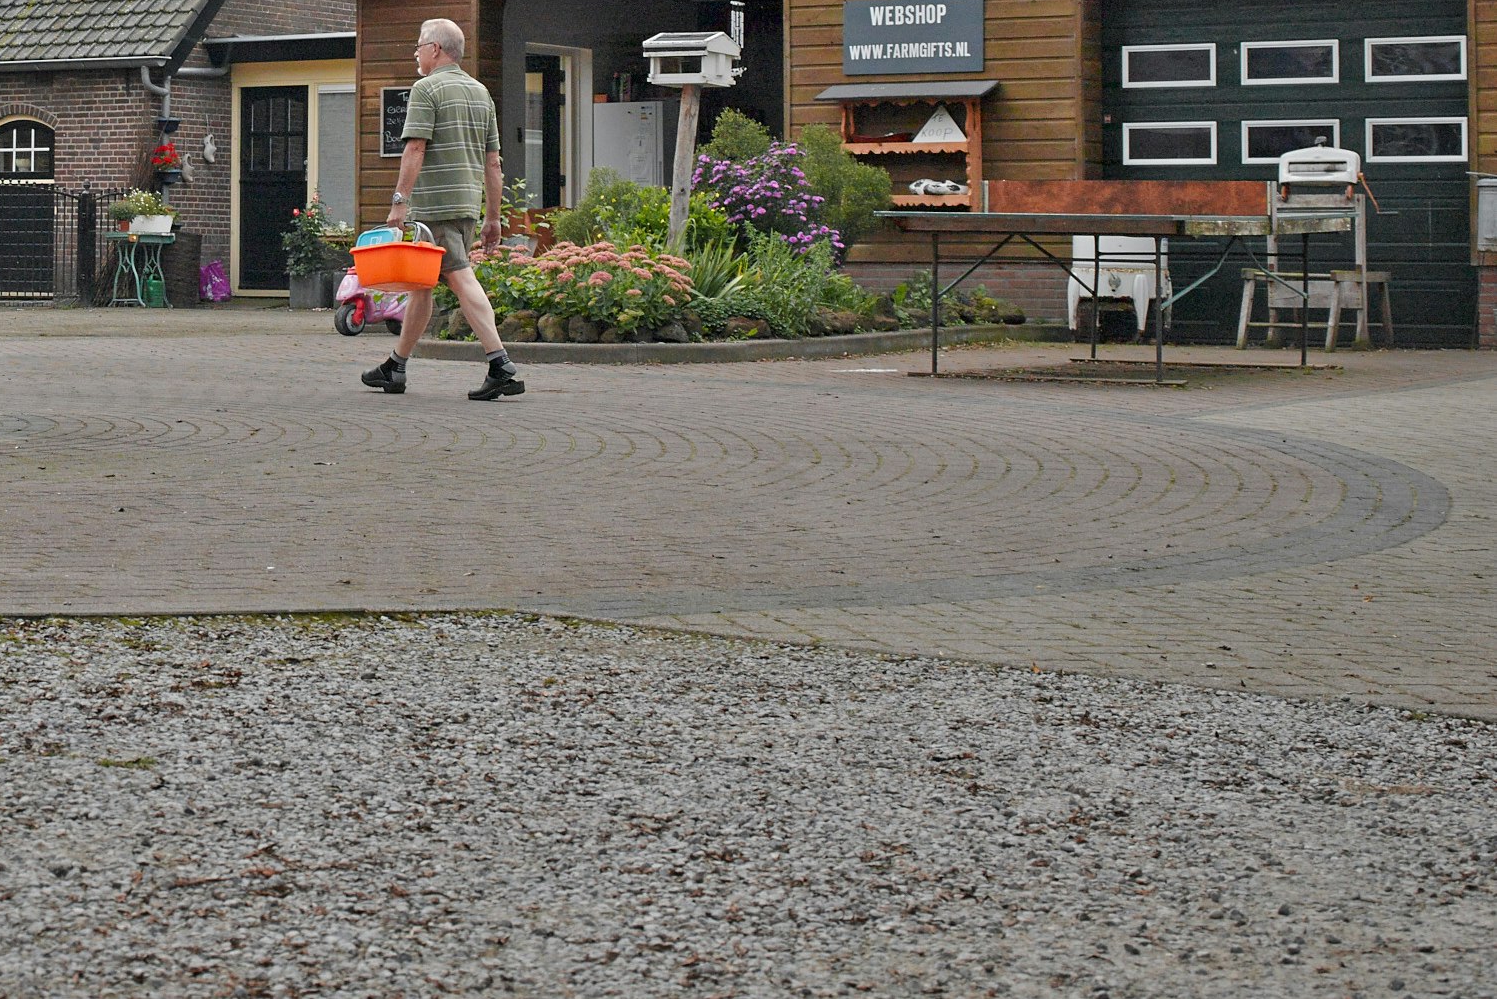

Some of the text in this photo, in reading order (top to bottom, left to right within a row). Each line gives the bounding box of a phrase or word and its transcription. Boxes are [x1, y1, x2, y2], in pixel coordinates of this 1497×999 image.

[869, 3, 947, 26] WEBSHOP
[849, 41, 972, 61] WWW.FARMGIFTS.NL
[920, 126, 954, 141] KOOP
